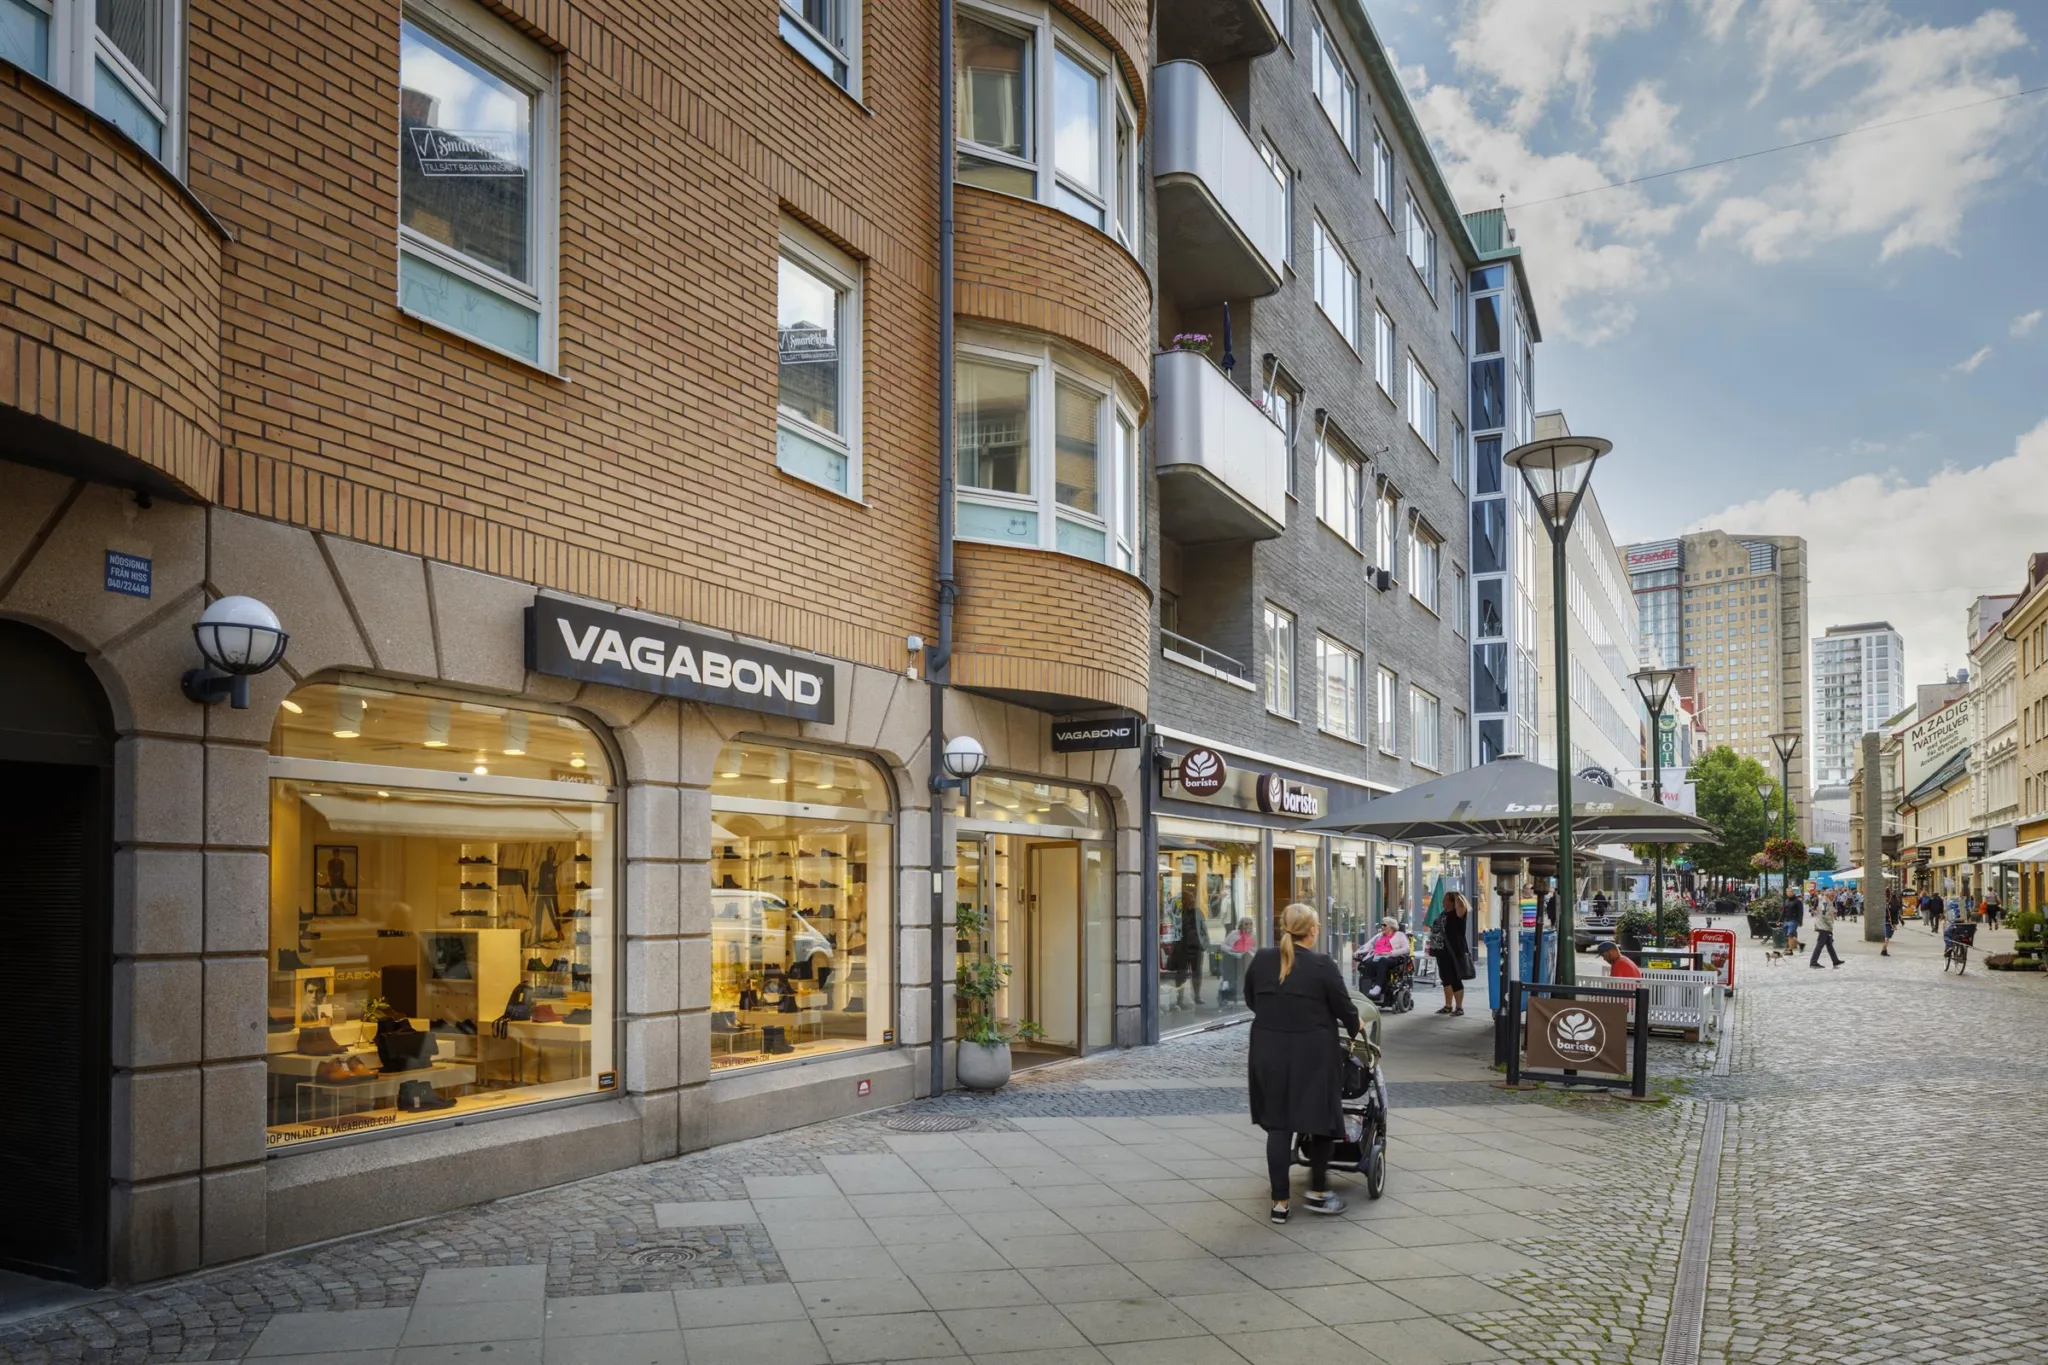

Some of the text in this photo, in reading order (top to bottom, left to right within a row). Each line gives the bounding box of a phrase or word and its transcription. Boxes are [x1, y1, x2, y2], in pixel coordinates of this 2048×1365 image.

[109, 555, 149, 571] NÖDSIGNAL
[111, 567, 148, 582] FRÅN HISS
[557, 618, 821, 705] VAGABOND
[1911, 700, 1968, 742] M. ZADIG
[1056, 727, 1131, 741] VAGABOND
[1912, 714, 1969, 752] TVÄTTPULVER
[1661, 733, 1673, 768] HOTE
[1185, 777, 1218, 788] barista
[1283, 779, 1318, 815] barista
[1505, 801, 1614, 813] barta
[336, 970, 381, 980] GABON
[1556, 1038, 1596, 1053] barista
[284, 1127, 317, 1142] ONLINE
[319, 1125, 332, 1136] AT
[332, 1113, 396, 1134] VAGABOND.COM
